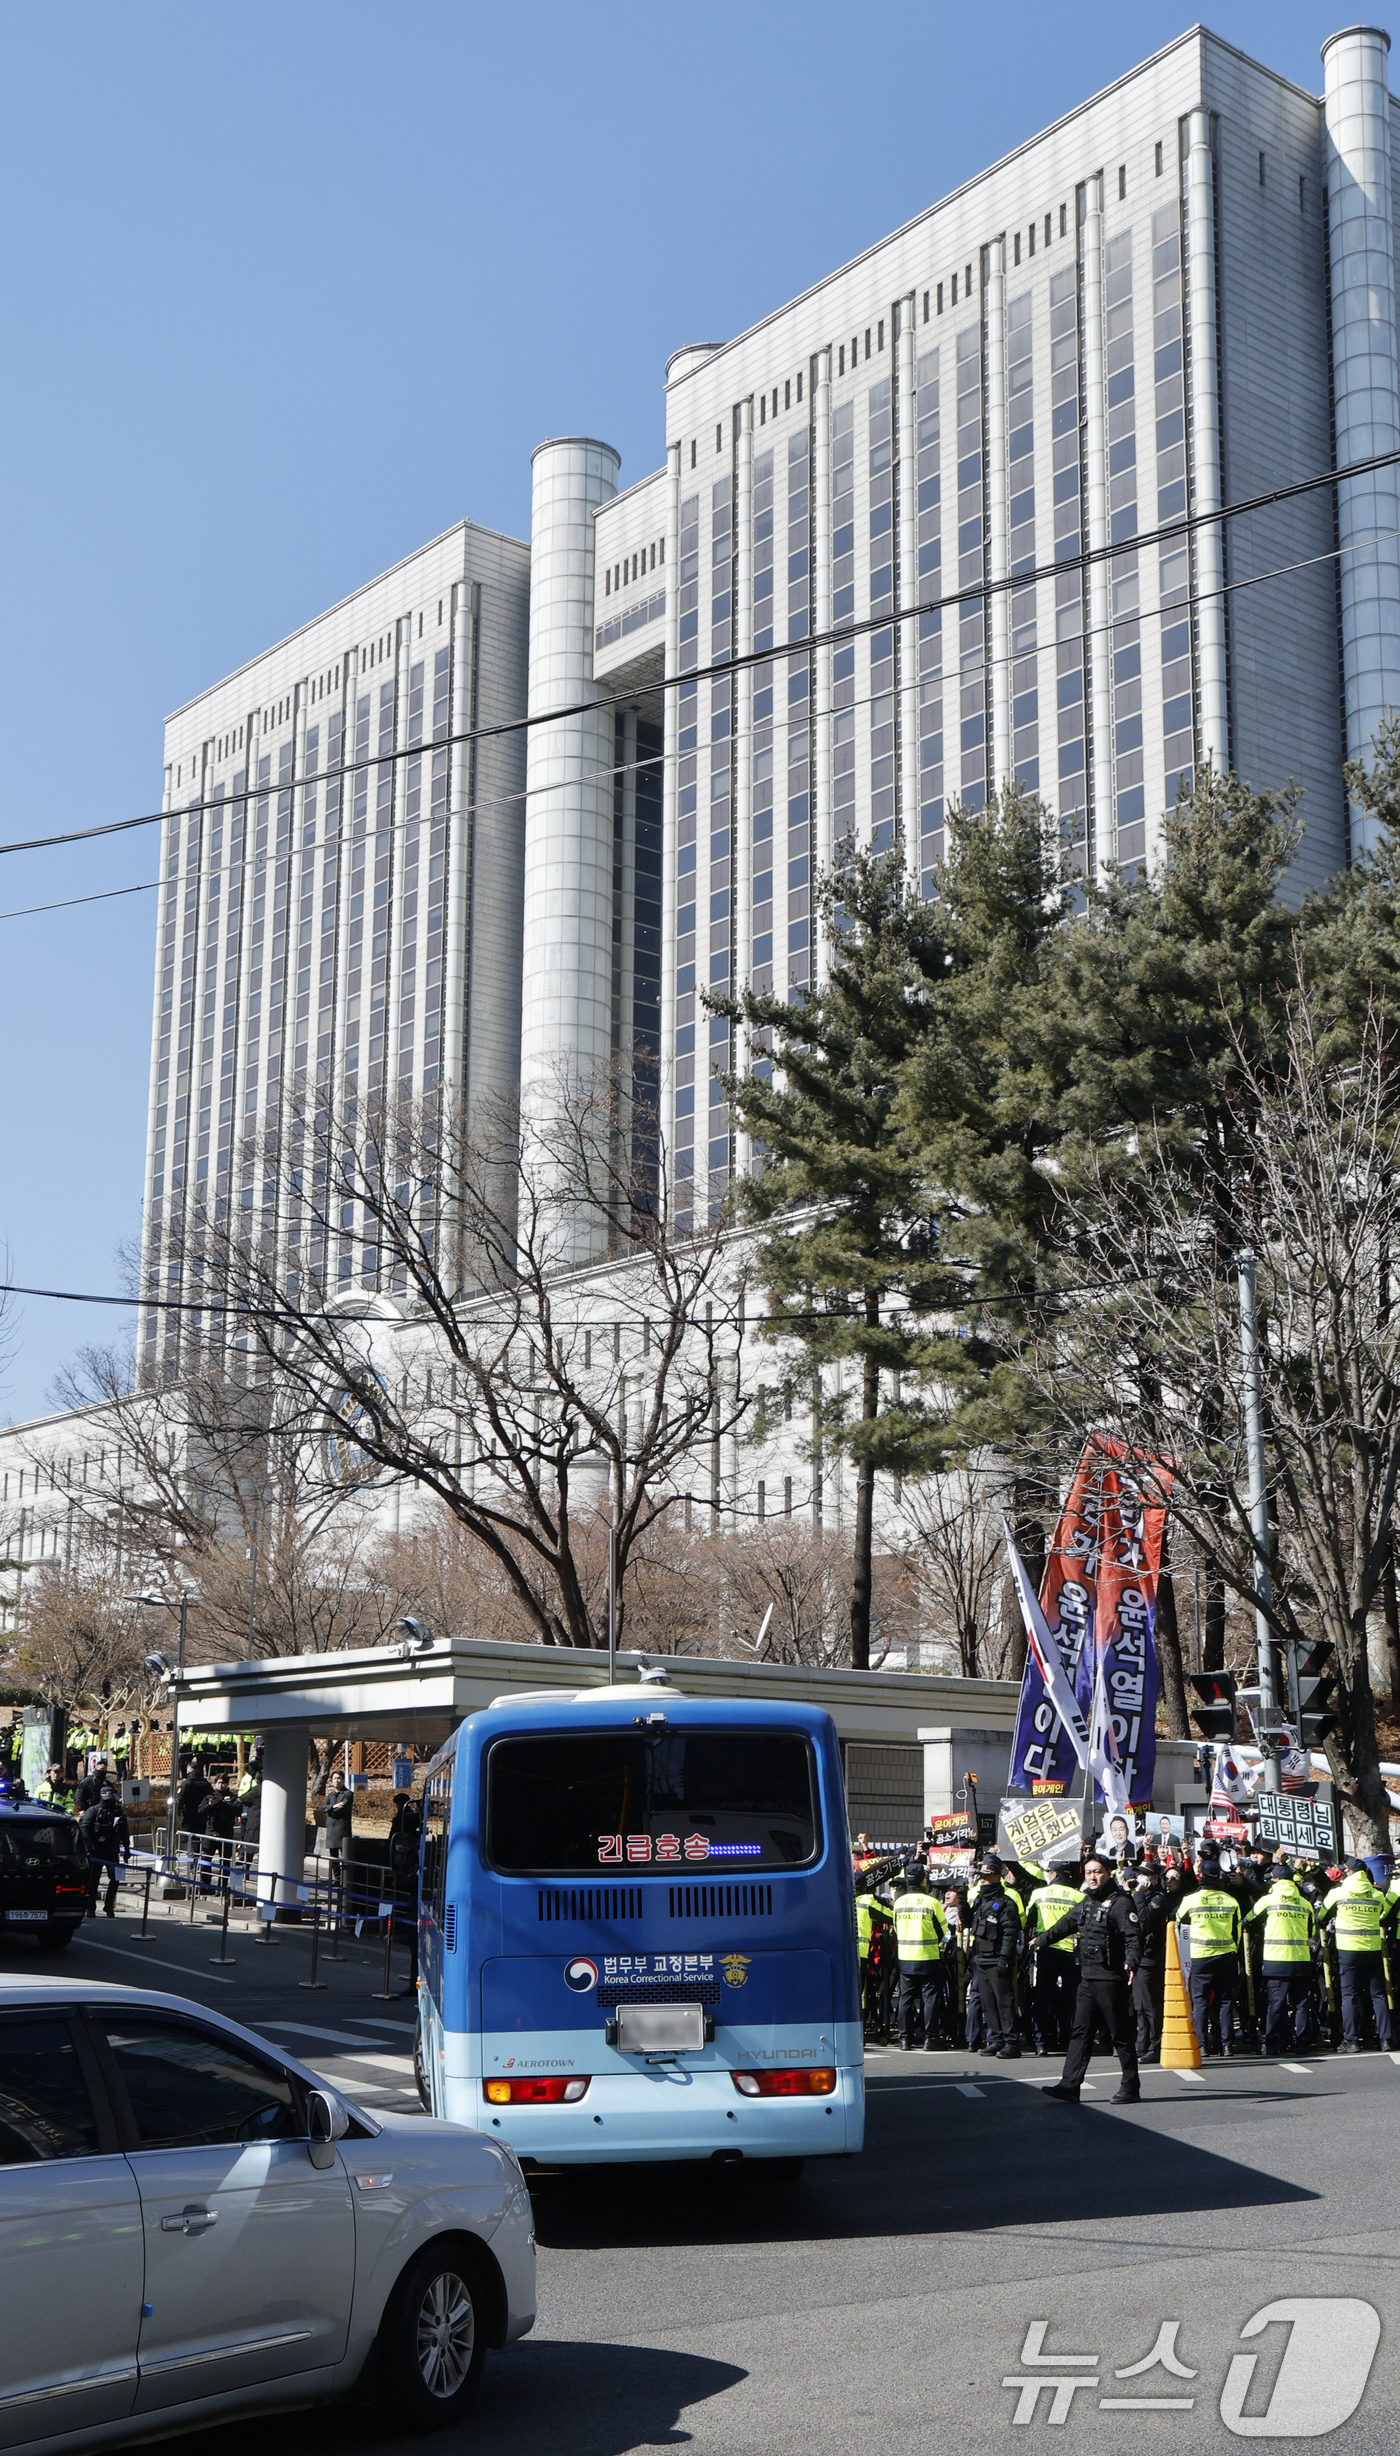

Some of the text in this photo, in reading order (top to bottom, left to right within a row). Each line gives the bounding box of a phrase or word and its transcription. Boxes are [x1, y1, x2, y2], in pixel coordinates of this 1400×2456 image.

[1023, 1579, 1089, 1780] 윤석이다
[1007, 1802, 1054, 1838] 계엄은
[1126, 1802, 1151, 1815] 어게인
[1260, 1796, 1329, 1824] 대통령님
[934, 1814, 969, 1831] 윤어게인
[1015, 1811, 1077, 1856] 정당했다
[1263, 1819, 1332, 1848] 힘내세요
[598, 1833, 710, 1862] 긴급호송
[604, 1954, 714, 1974] 법무부 교정본부
[604, 1972, 714, 1984] Korea Correctional Service
[517, 2059, 575, 2068] AEROTOWN
[737, 2048, 817, 2060] HYUNDAI
